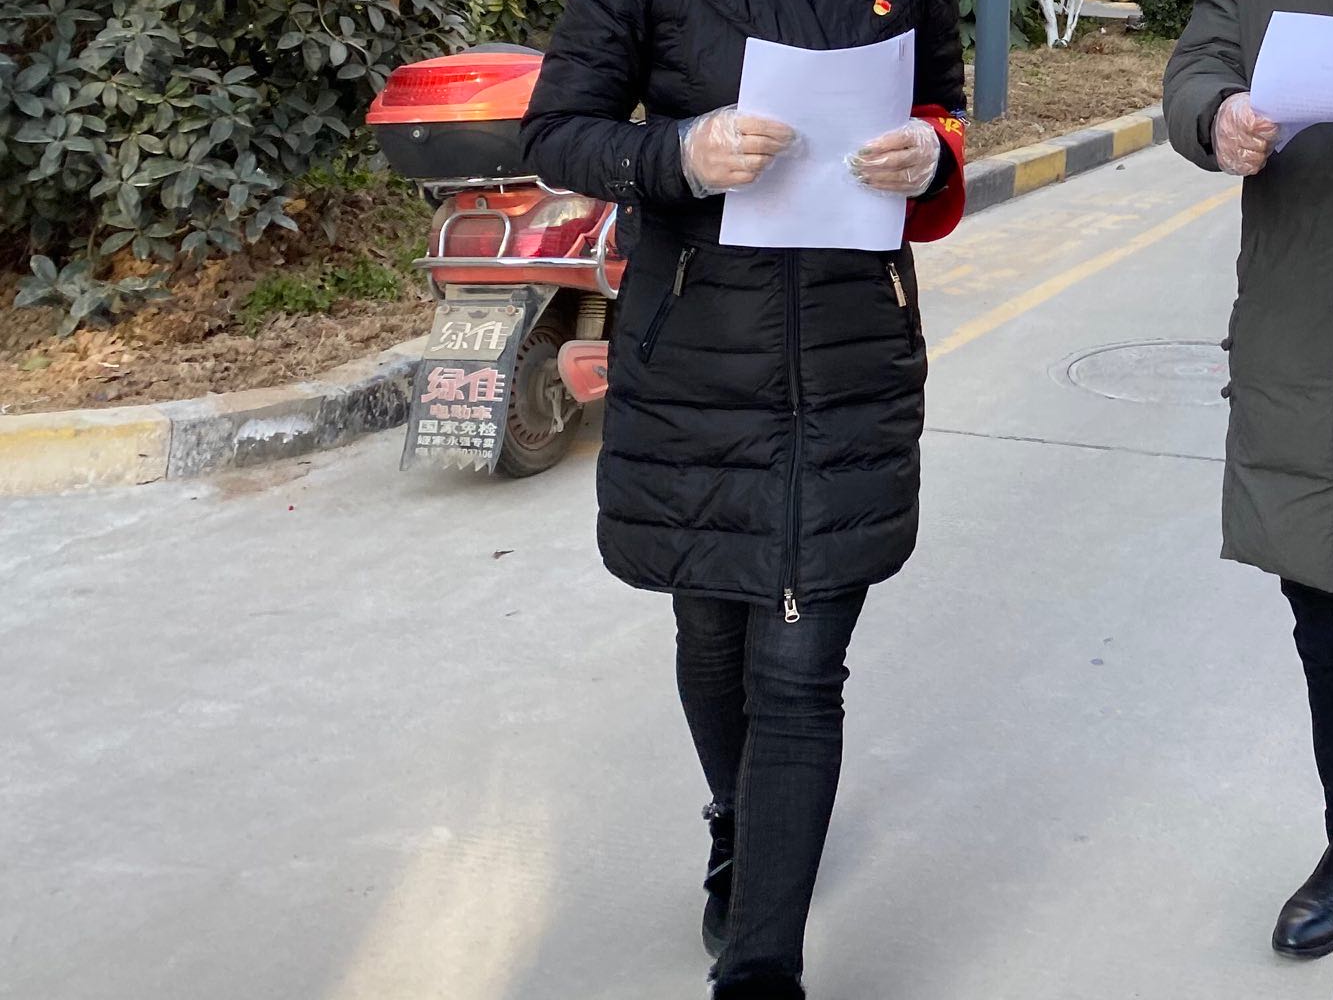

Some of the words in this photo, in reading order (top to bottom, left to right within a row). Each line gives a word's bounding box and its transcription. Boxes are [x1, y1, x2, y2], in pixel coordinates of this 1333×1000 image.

[432, 321, 508, 351] 绿佳
[421, 367, 505, 403] 绿佳
[430, 404, 492, 420] 电动车
[418, 420, 497, 436] 国家免检
